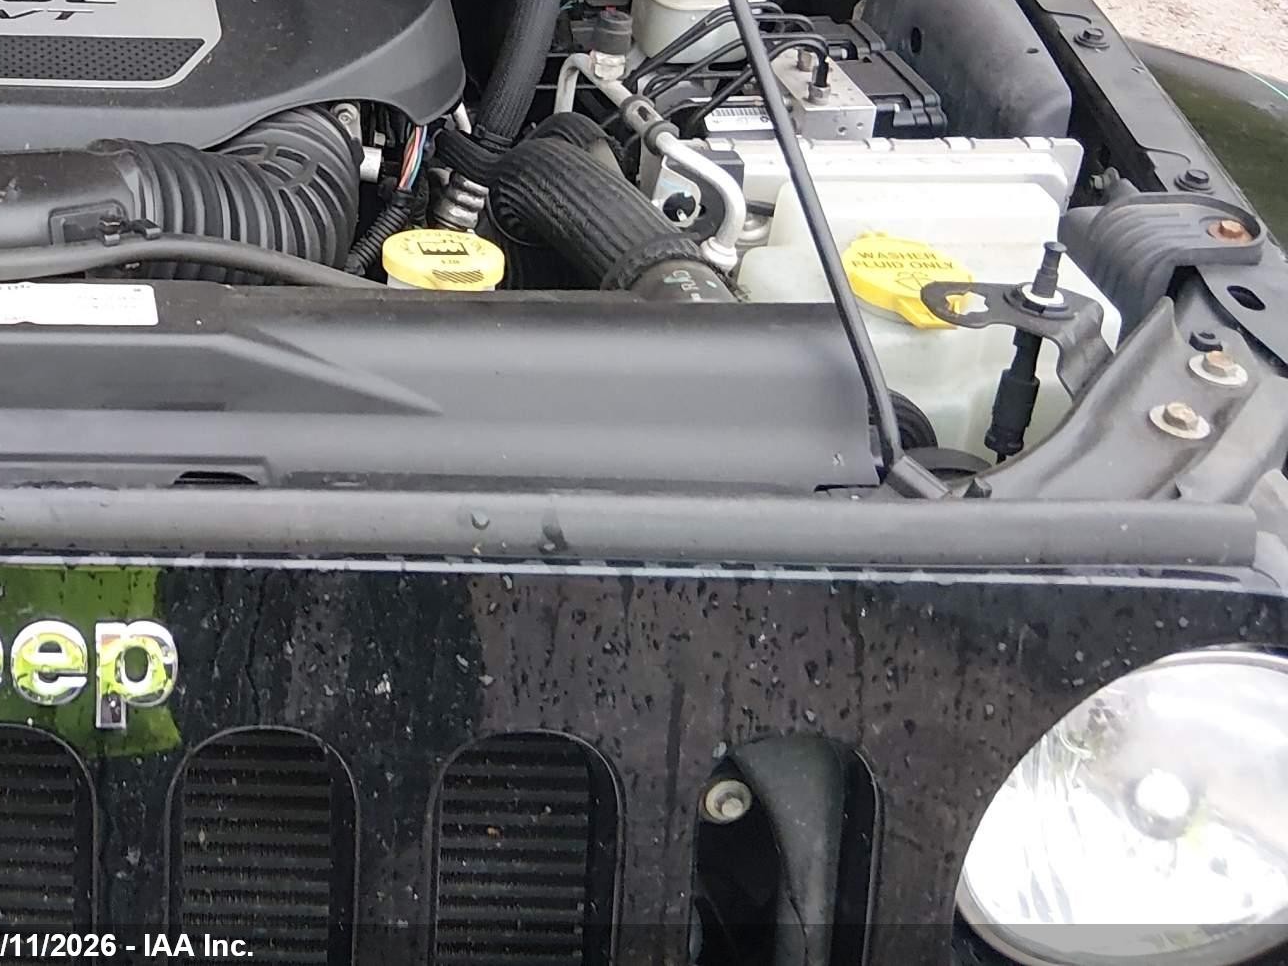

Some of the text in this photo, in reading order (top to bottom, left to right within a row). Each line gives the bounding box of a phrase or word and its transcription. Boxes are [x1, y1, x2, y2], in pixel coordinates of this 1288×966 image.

[858, 252, 937, 260] WASHER
[852, 261, 954, 270] FLUID ONLY
